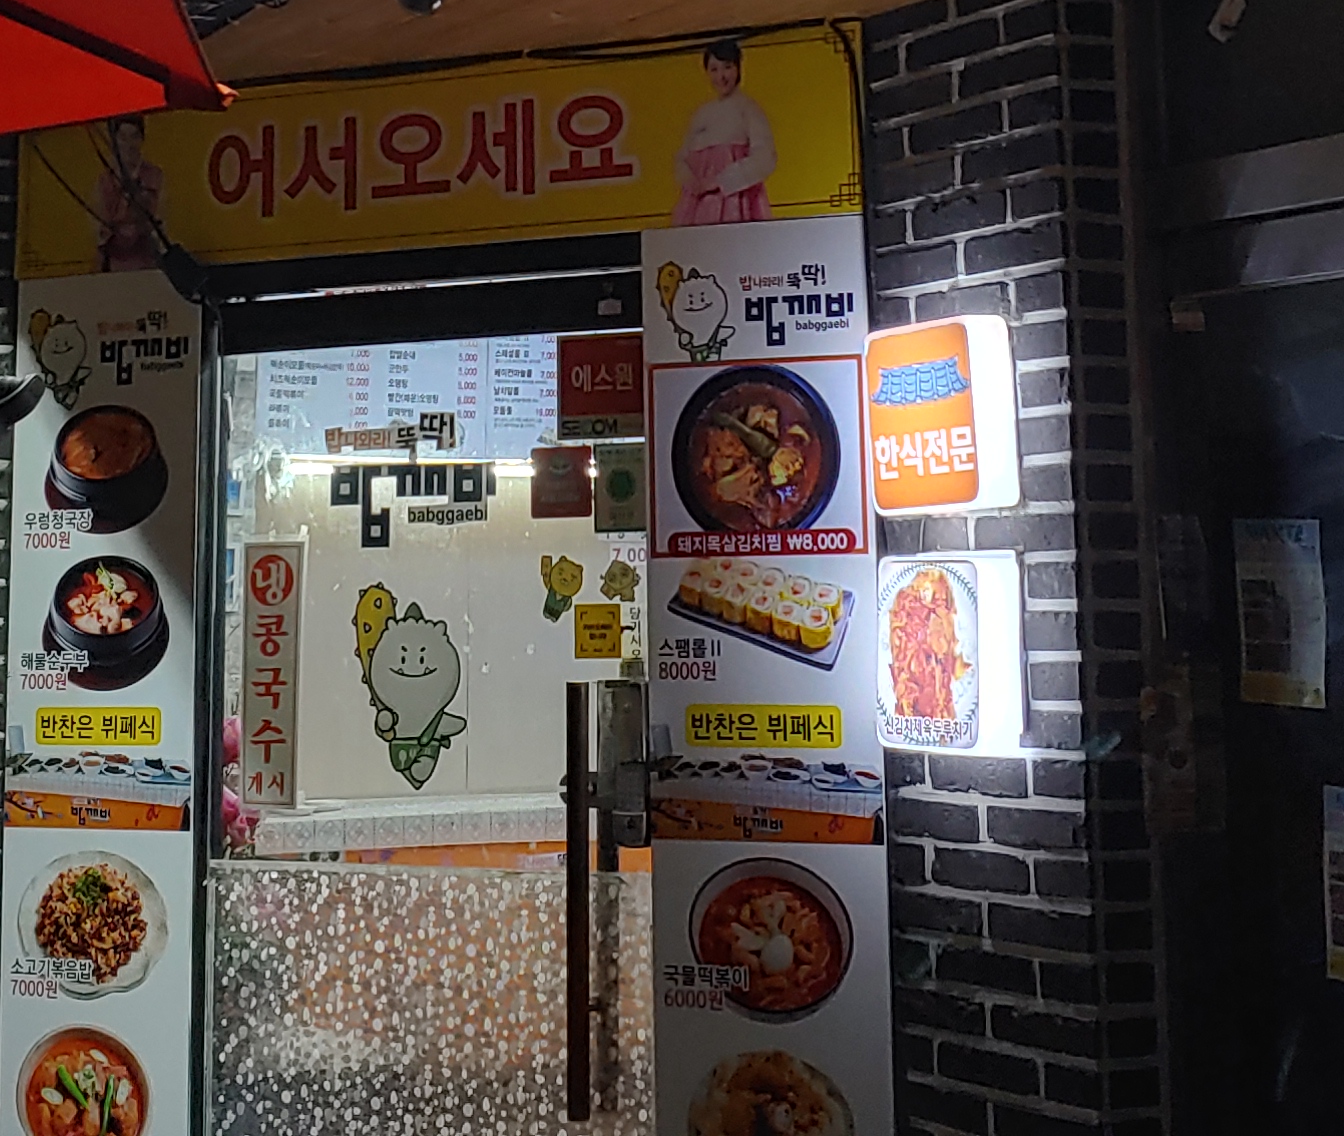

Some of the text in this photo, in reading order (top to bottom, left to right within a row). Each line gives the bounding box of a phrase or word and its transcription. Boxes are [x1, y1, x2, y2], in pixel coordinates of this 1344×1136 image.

[208, 93, 634, 218] 어서오세요
[745, 292, 854, 346] 밥깨비
[795, 318, 849, 331] babggaebi
[101, 336, 189, 386] 밥깨비
[571, 363, 634, 393] 에스원
[875, 425, 976, 480] 한식전문
[24, 511, 93, 531] 우렁청국장
[408, 505, 488, 525] babggaebi
[24, 531, 71, 549] 7000원
[677, 532, 782, 553] 돼지목살김치찜
[21, 652, 88, 671] 해물순두부
[658, 661, 716, 681] 8000원
[20, 672, 67, 691] 7000원
[40, 714, 155, 740] 반찬은 뷔페식
[691, 713, 834, 743] 반찬은 뷔페식
[10, 958, 92, 981] 소고기볶음밥
[663, 965, 750, 990] 국물떡볶이
[10, 979, 58, 999] 7000원
[664, 989, 723, 1011] 6000원
